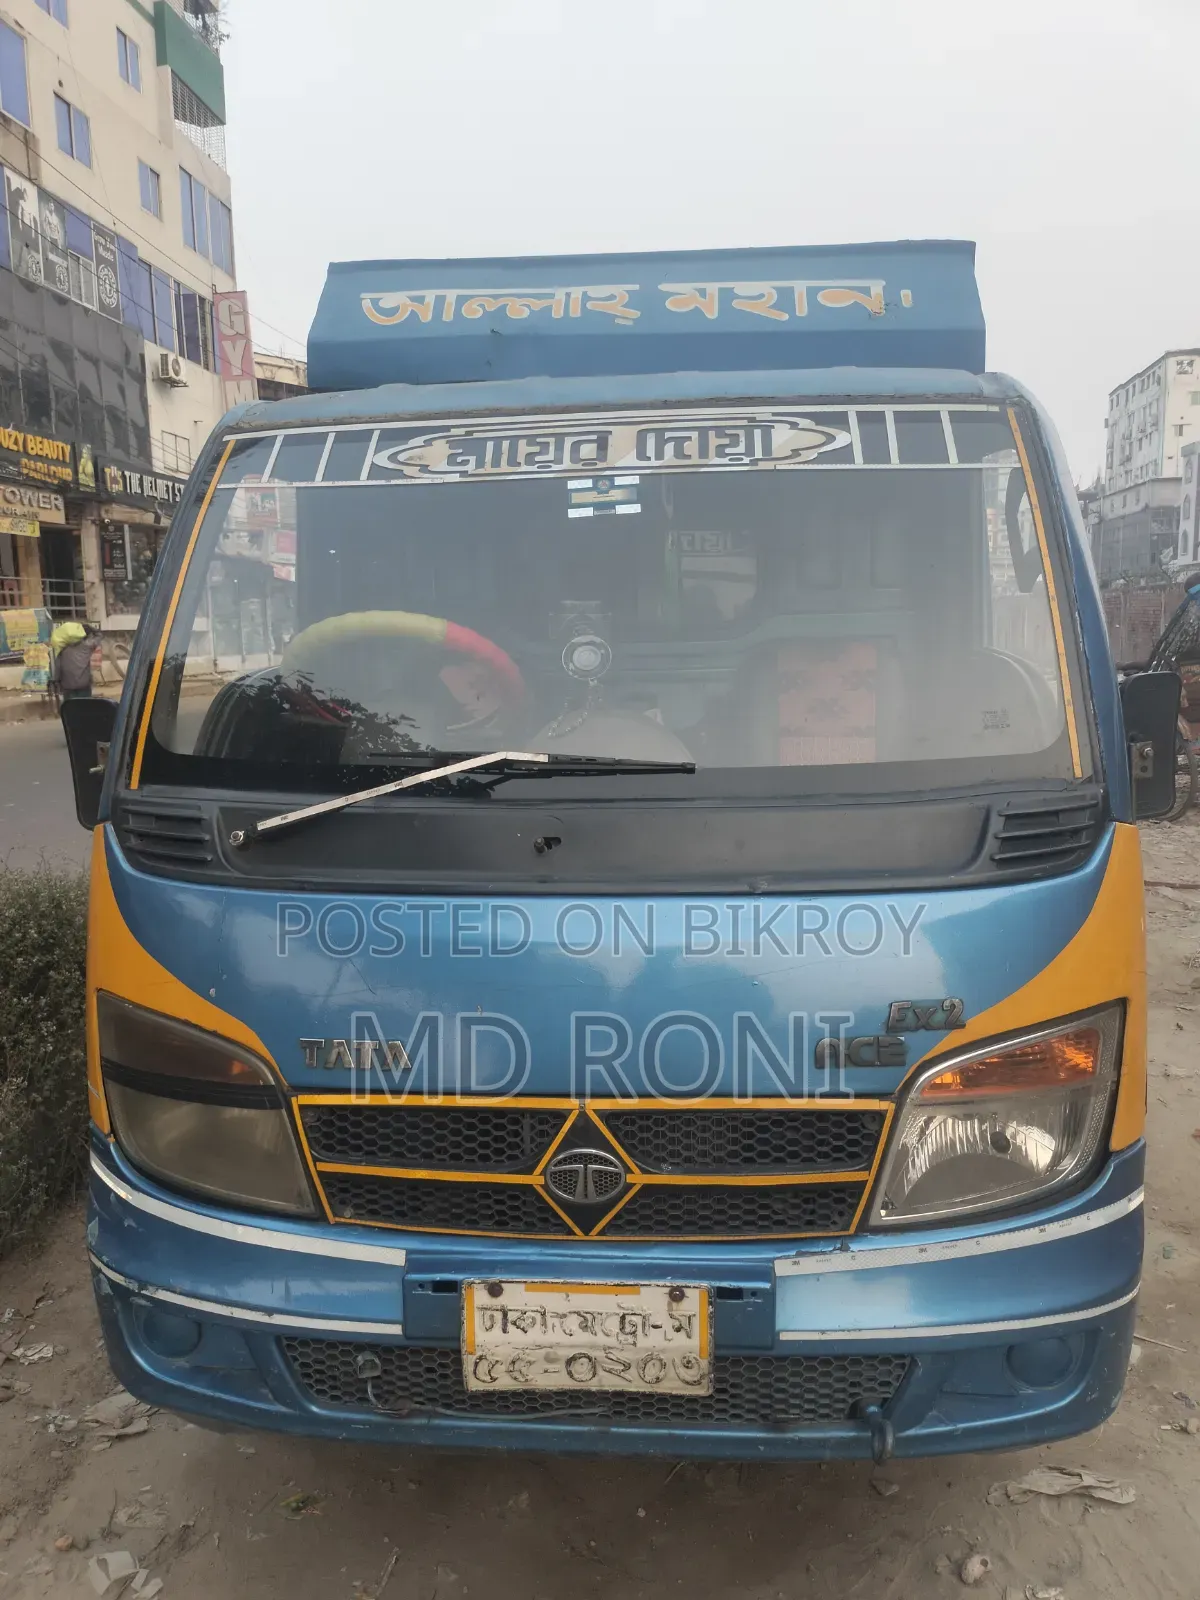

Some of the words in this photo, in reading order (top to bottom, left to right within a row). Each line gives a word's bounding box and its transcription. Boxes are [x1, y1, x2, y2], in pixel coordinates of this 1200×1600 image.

[26, 434, 71, 464] BEAUTY
[0, 485, 65, 511] OWER
[124, 470, 141, 494] THE
[143, 475, 173, 503] HELMET
[299, 1037, 412, 1070] TATA
[814, 1036, 907, 1069] ACE
